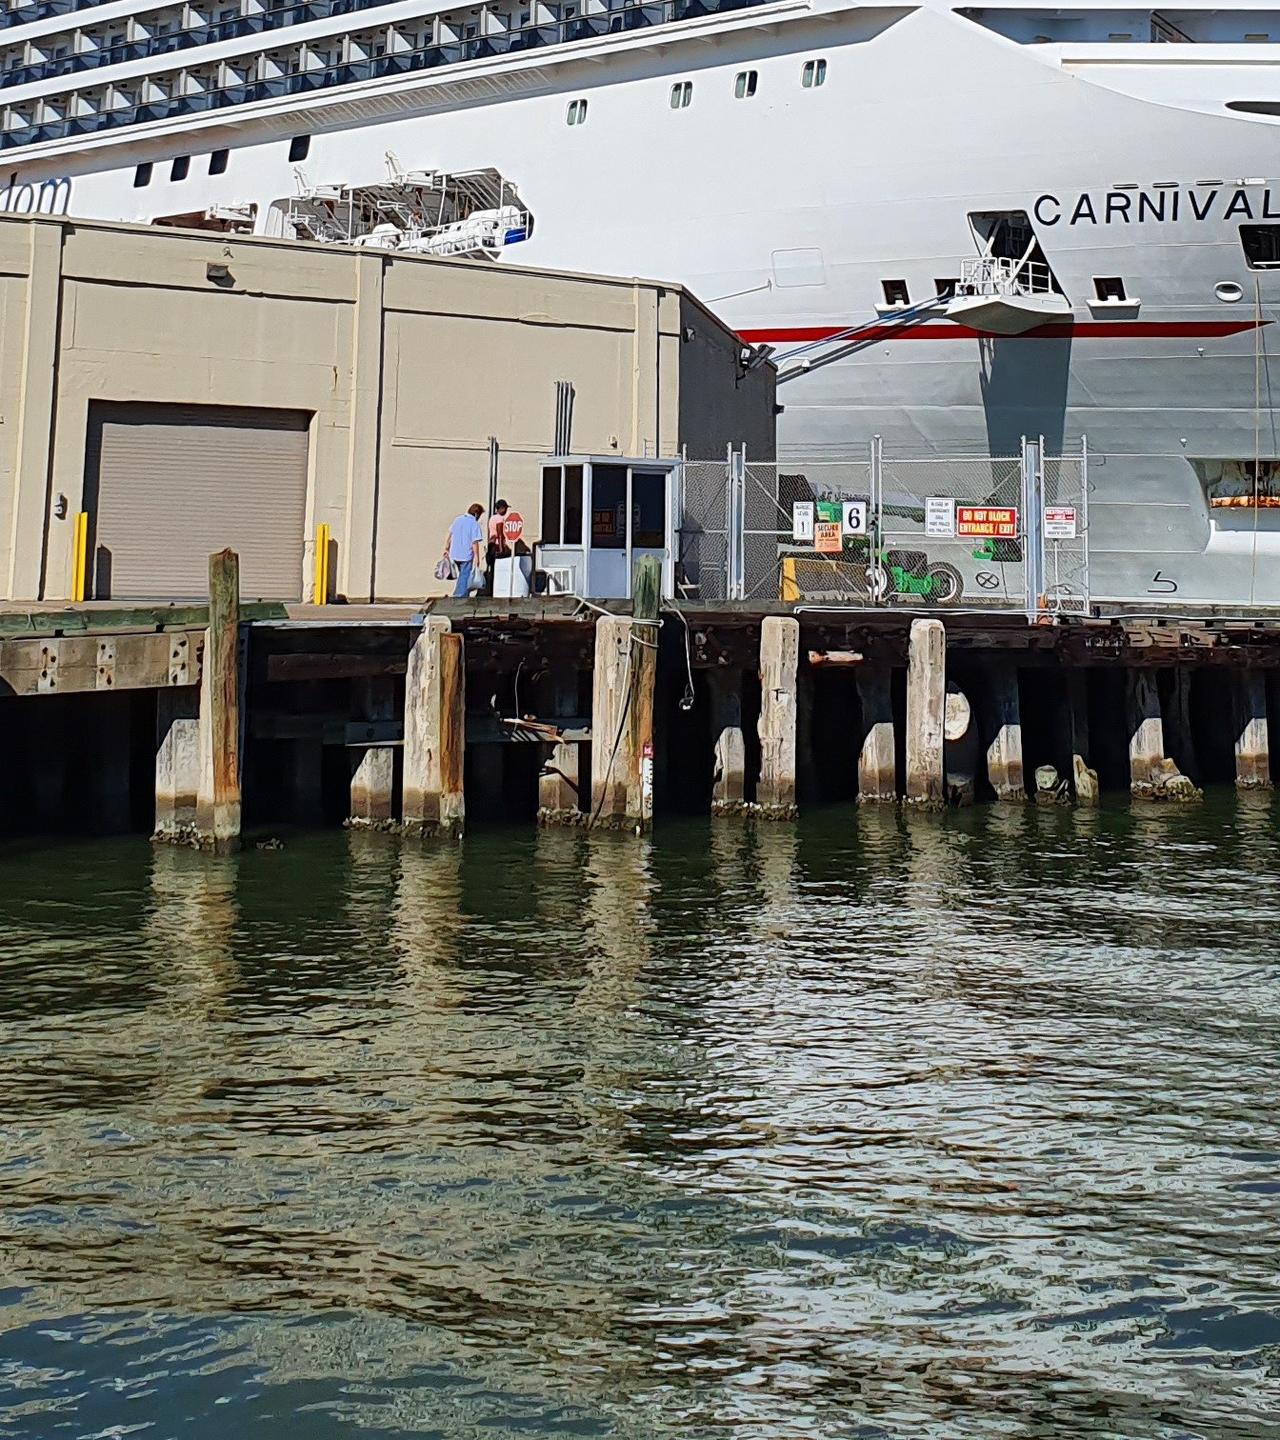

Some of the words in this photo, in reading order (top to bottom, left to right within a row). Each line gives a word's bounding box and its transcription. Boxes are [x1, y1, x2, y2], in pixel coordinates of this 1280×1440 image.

[848, 507, 861, 529] 6
[963, 510, 973, 521] DO
[973, 510, 987, 521] NOT
[988, 511, 1011, 522] BLOCK
[504, 520, 523, 533] STOP
[959, 522, 994, 534] ENTRANCE
[999, 523, 1014, 535] EXIT
